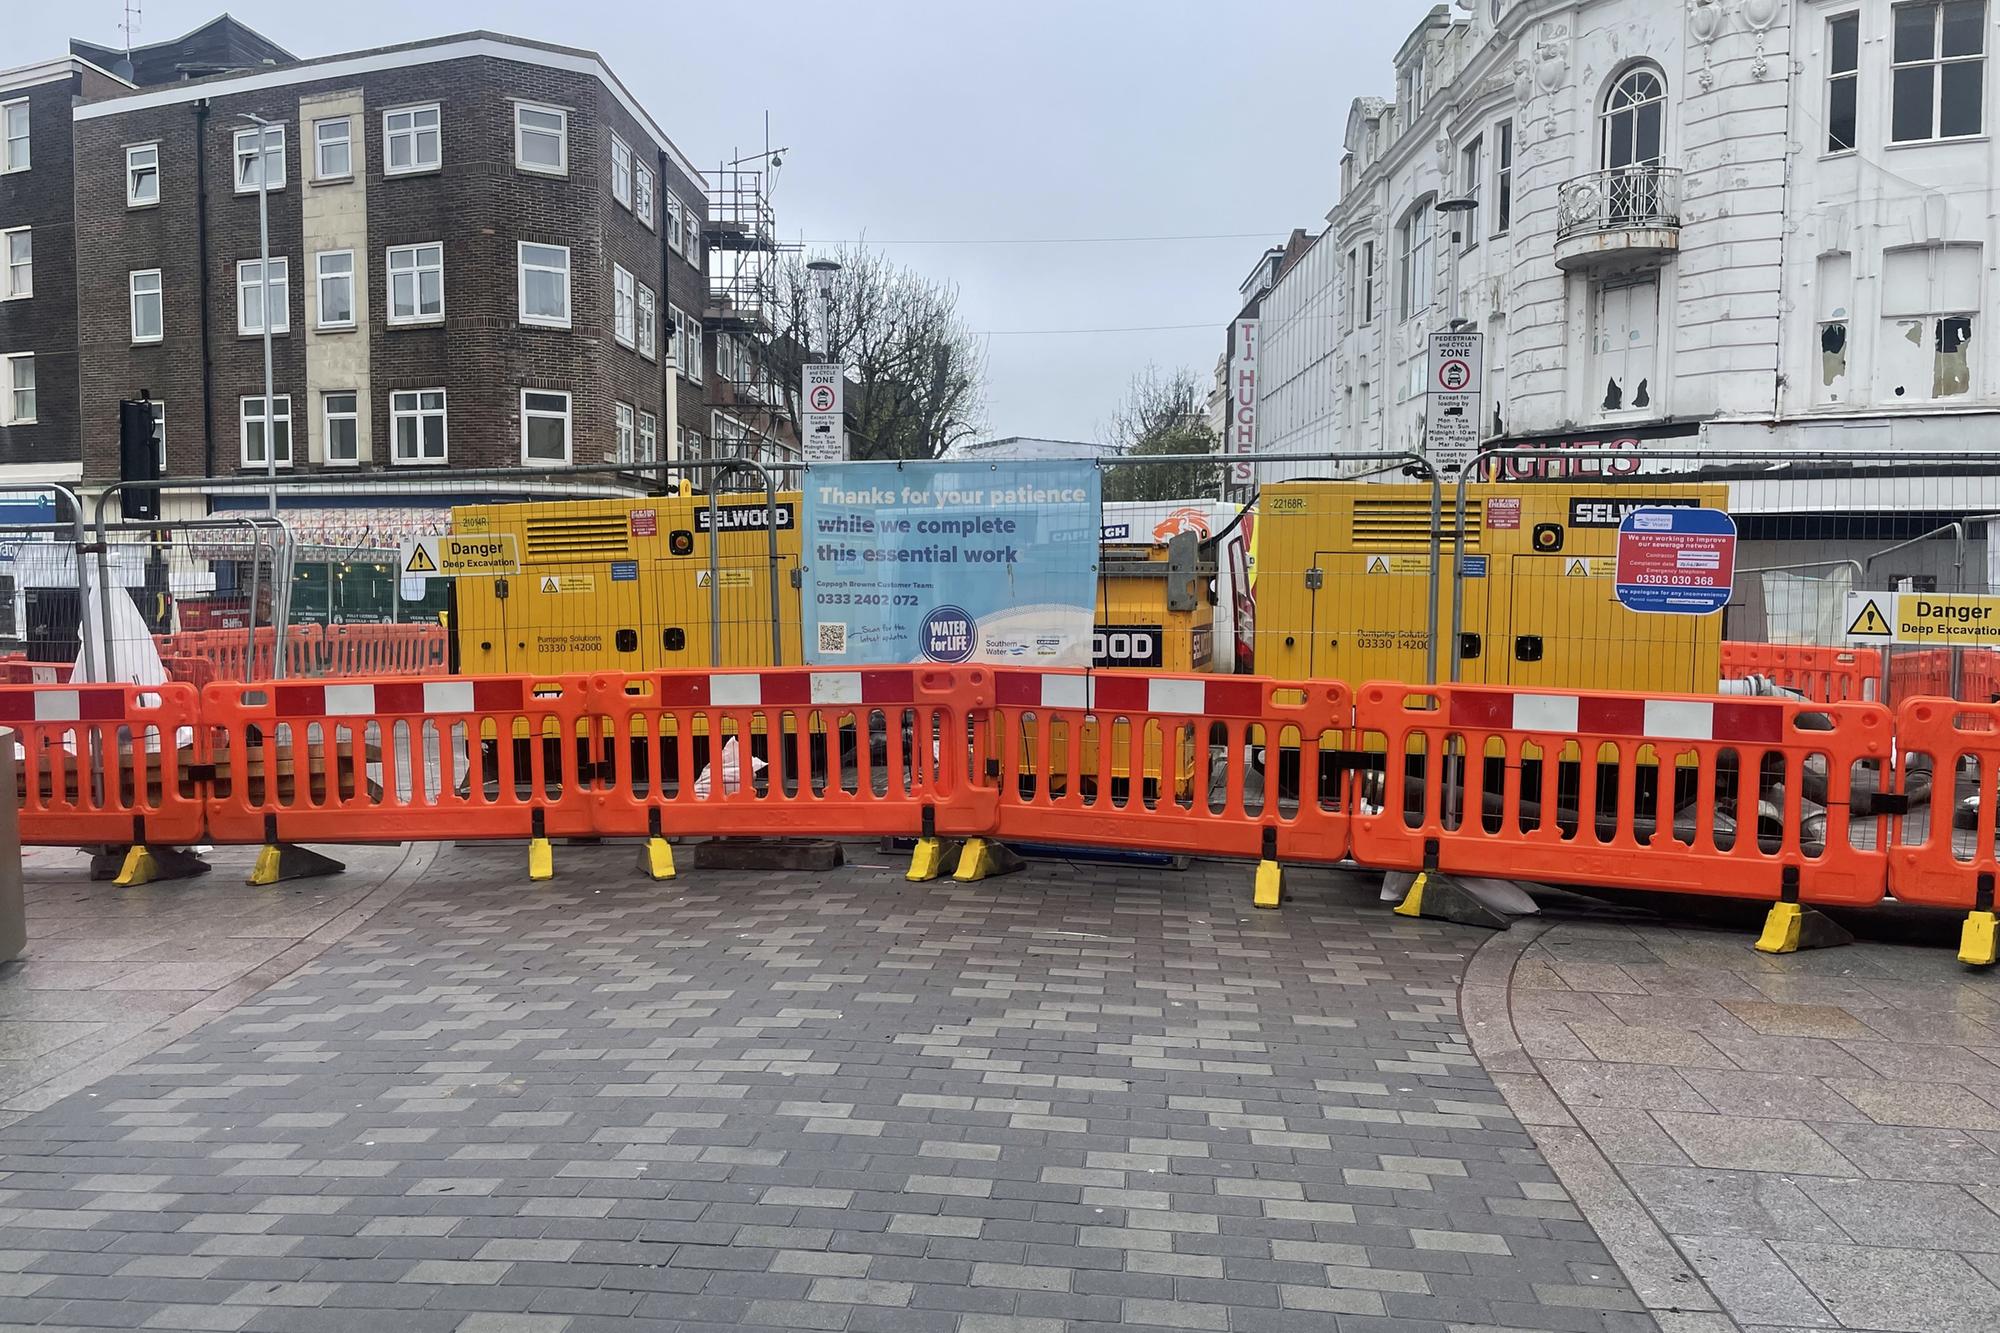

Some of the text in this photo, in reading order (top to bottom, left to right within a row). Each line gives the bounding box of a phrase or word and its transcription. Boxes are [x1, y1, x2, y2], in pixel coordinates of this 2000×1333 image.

[1440, 349, 1470, 357] ZONE
[819, 485, 1086, 510] Thanks for your patience
[1274, 499, 1303, 509] 22168R
[817, 514, 1016, 537] while we complete
[452, 543, 503, 557] Danger
[817, 543, 1018, 563] this essential work
[443, 560, 464, 568] Deep
[1637, 574, 1714, 585] 03303 030 368
[817, 594, 918, 606] 0333 2402 072
[1917, 602, 1992, 622] Danger
[930, 620, 967, 636] WATER
[1902, 624, 1933, 634] Deep
[1358, 629, 1429, 639] Pumping Solutio
[539, 643, 602, 652] 03330 142000
[930, 636, 967, 652] for LIFE
[1358, 639, 1392, 648] 03330
